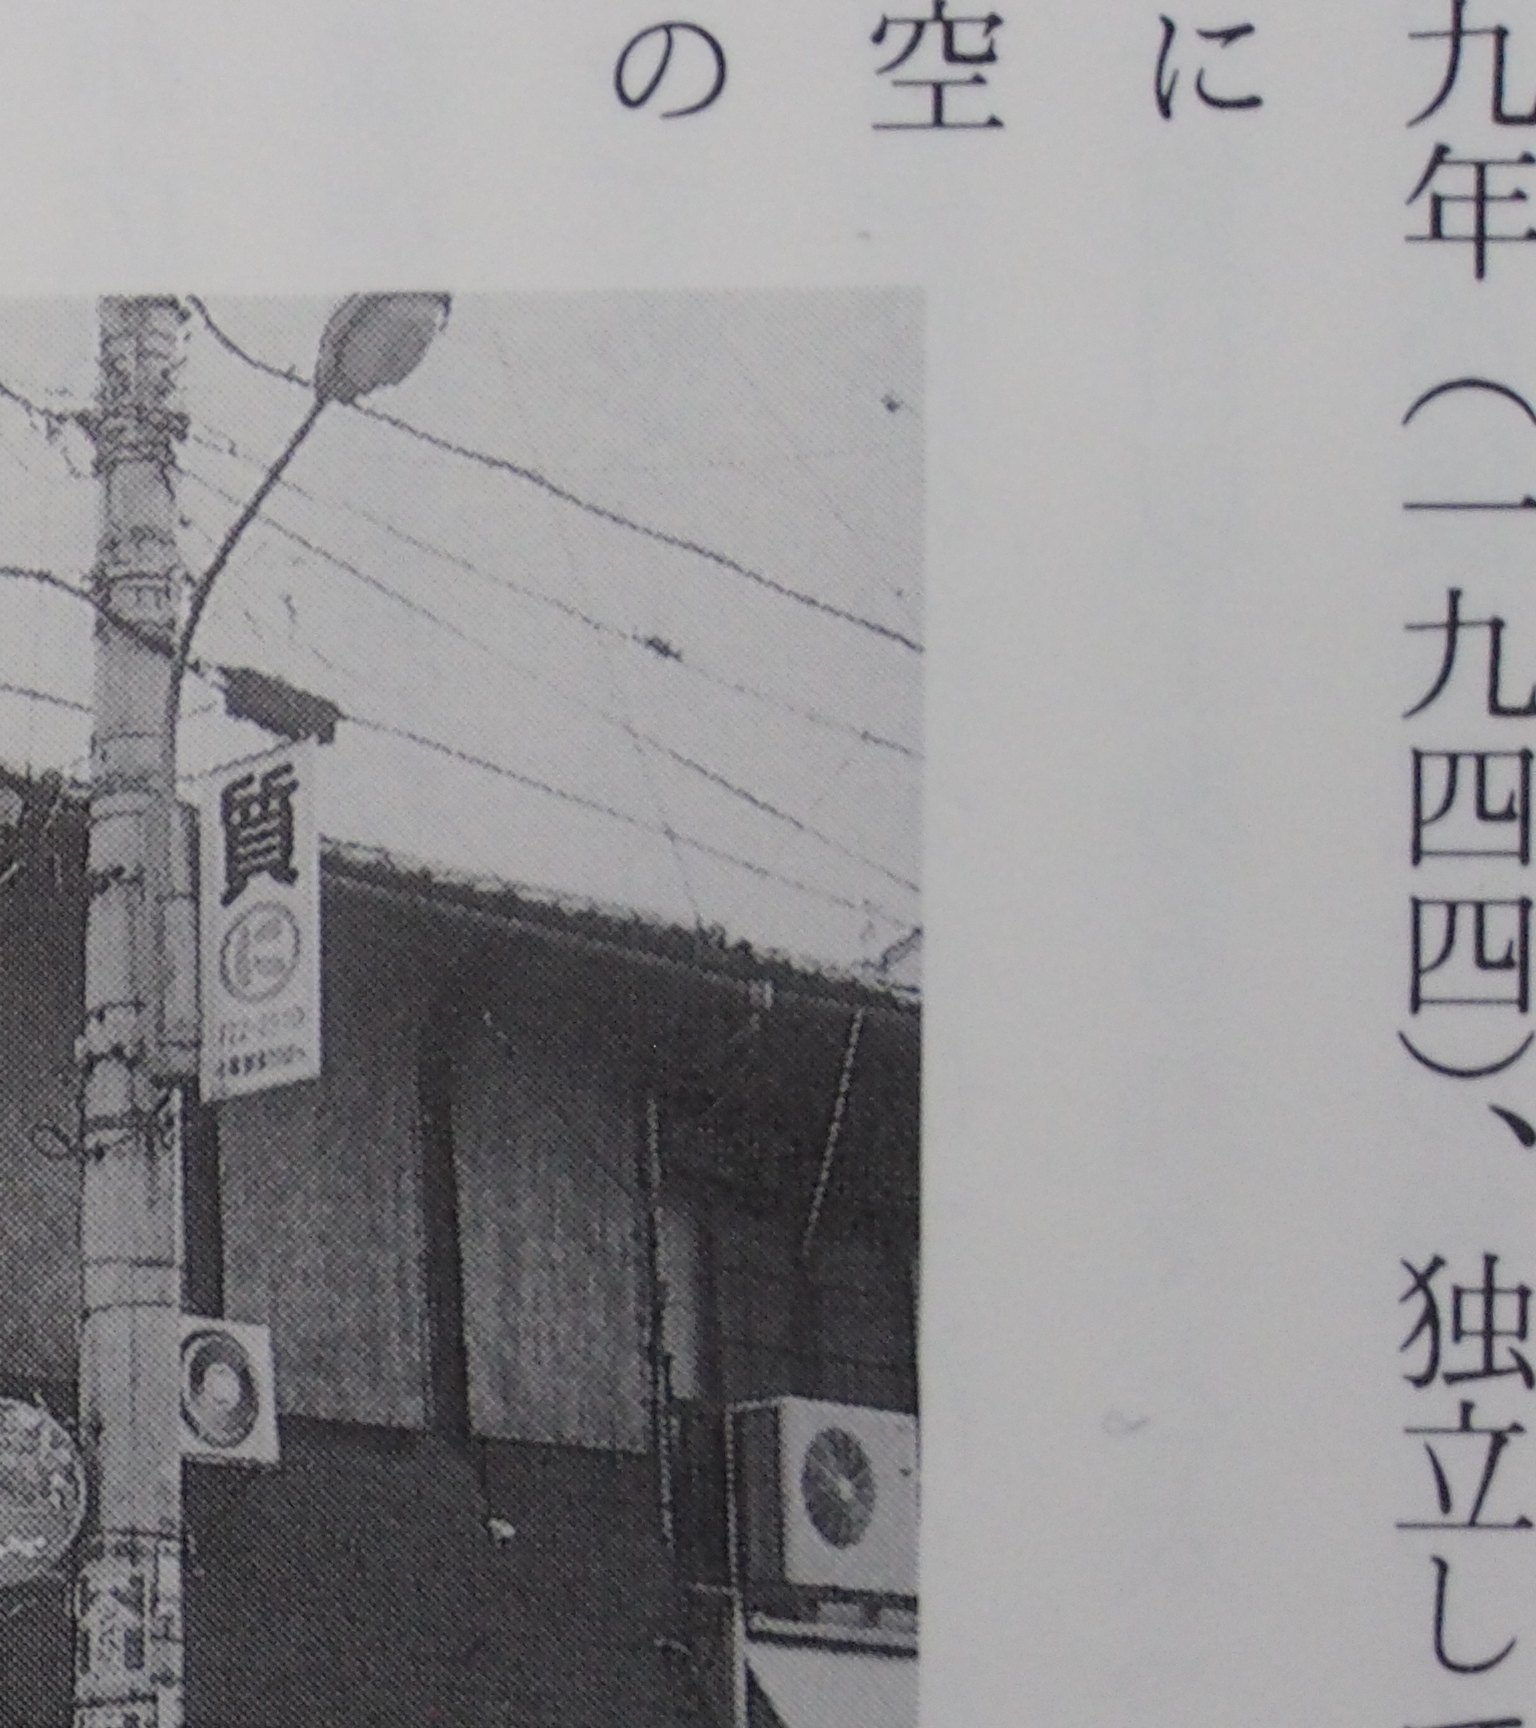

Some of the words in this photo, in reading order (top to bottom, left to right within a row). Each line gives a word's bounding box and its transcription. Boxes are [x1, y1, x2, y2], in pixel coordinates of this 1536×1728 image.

[613, 20, 729, 119] の
[870, 0, 1004, 131] 空
[1153, 14, 1264, 122] に
[221, 761, 300, 908] 質
